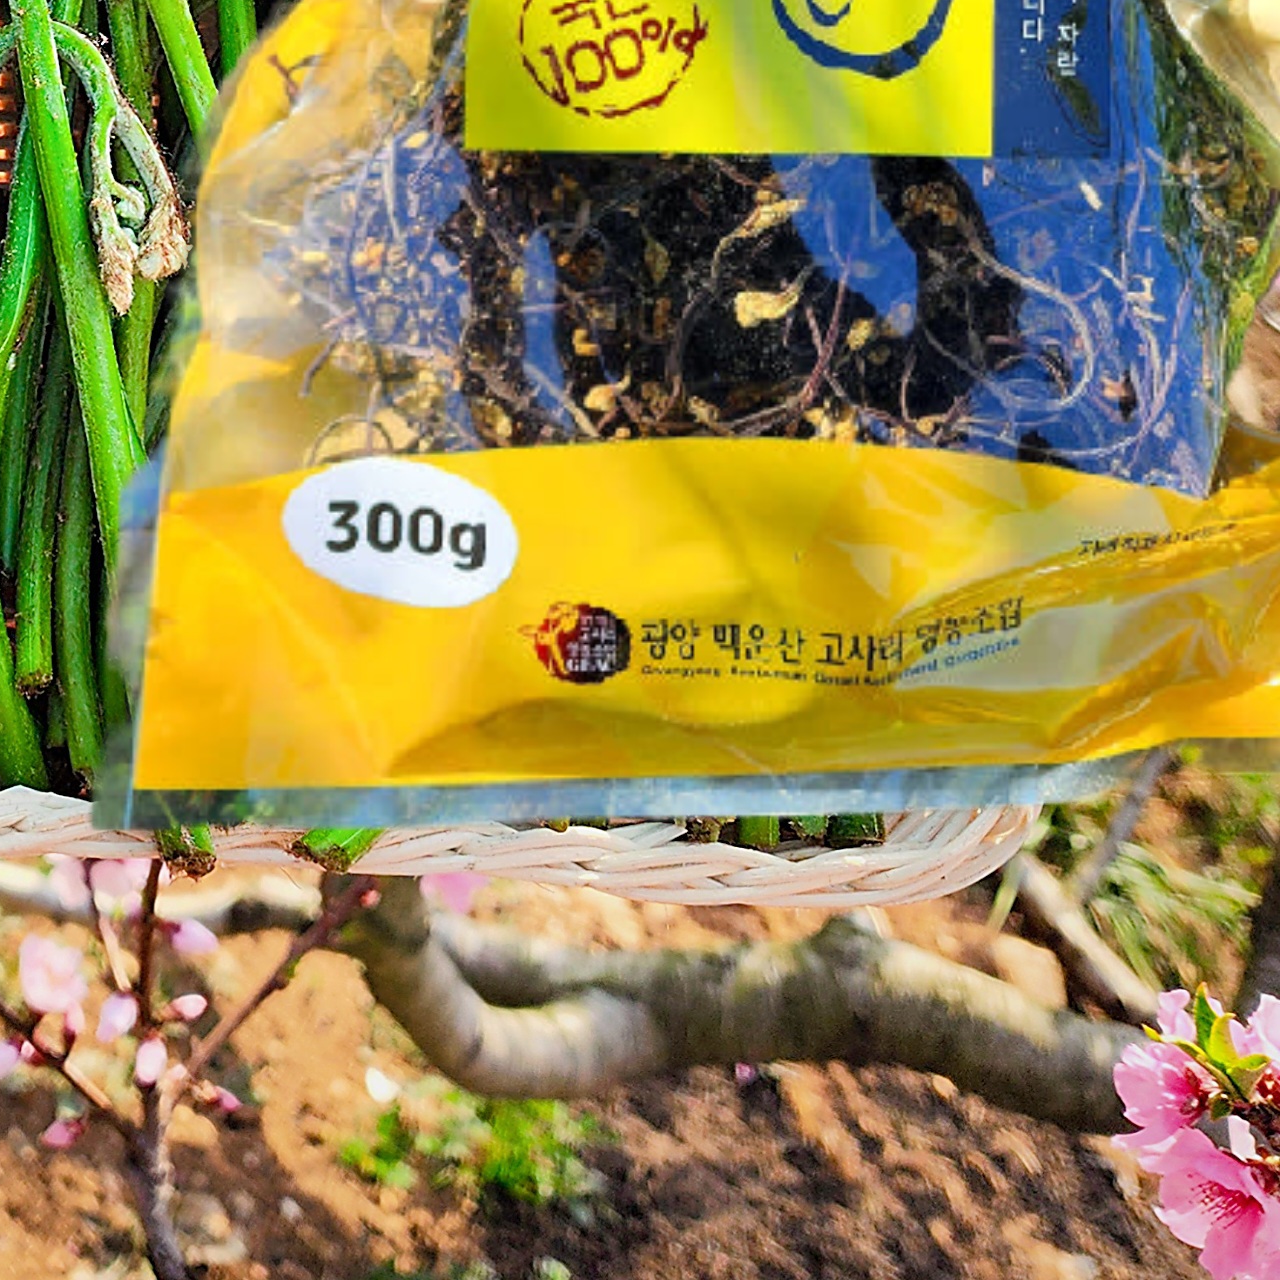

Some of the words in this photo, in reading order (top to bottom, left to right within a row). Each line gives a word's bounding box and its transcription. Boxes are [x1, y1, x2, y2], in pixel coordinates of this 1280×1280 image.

[540, 17, 702, 106] 100%
[325, 499, 487, 572] 300g
[640, 618, 702, 661] 광양
[712, 620, 807, 666] 백운산
[815, 629, 904, 671] 고사리
